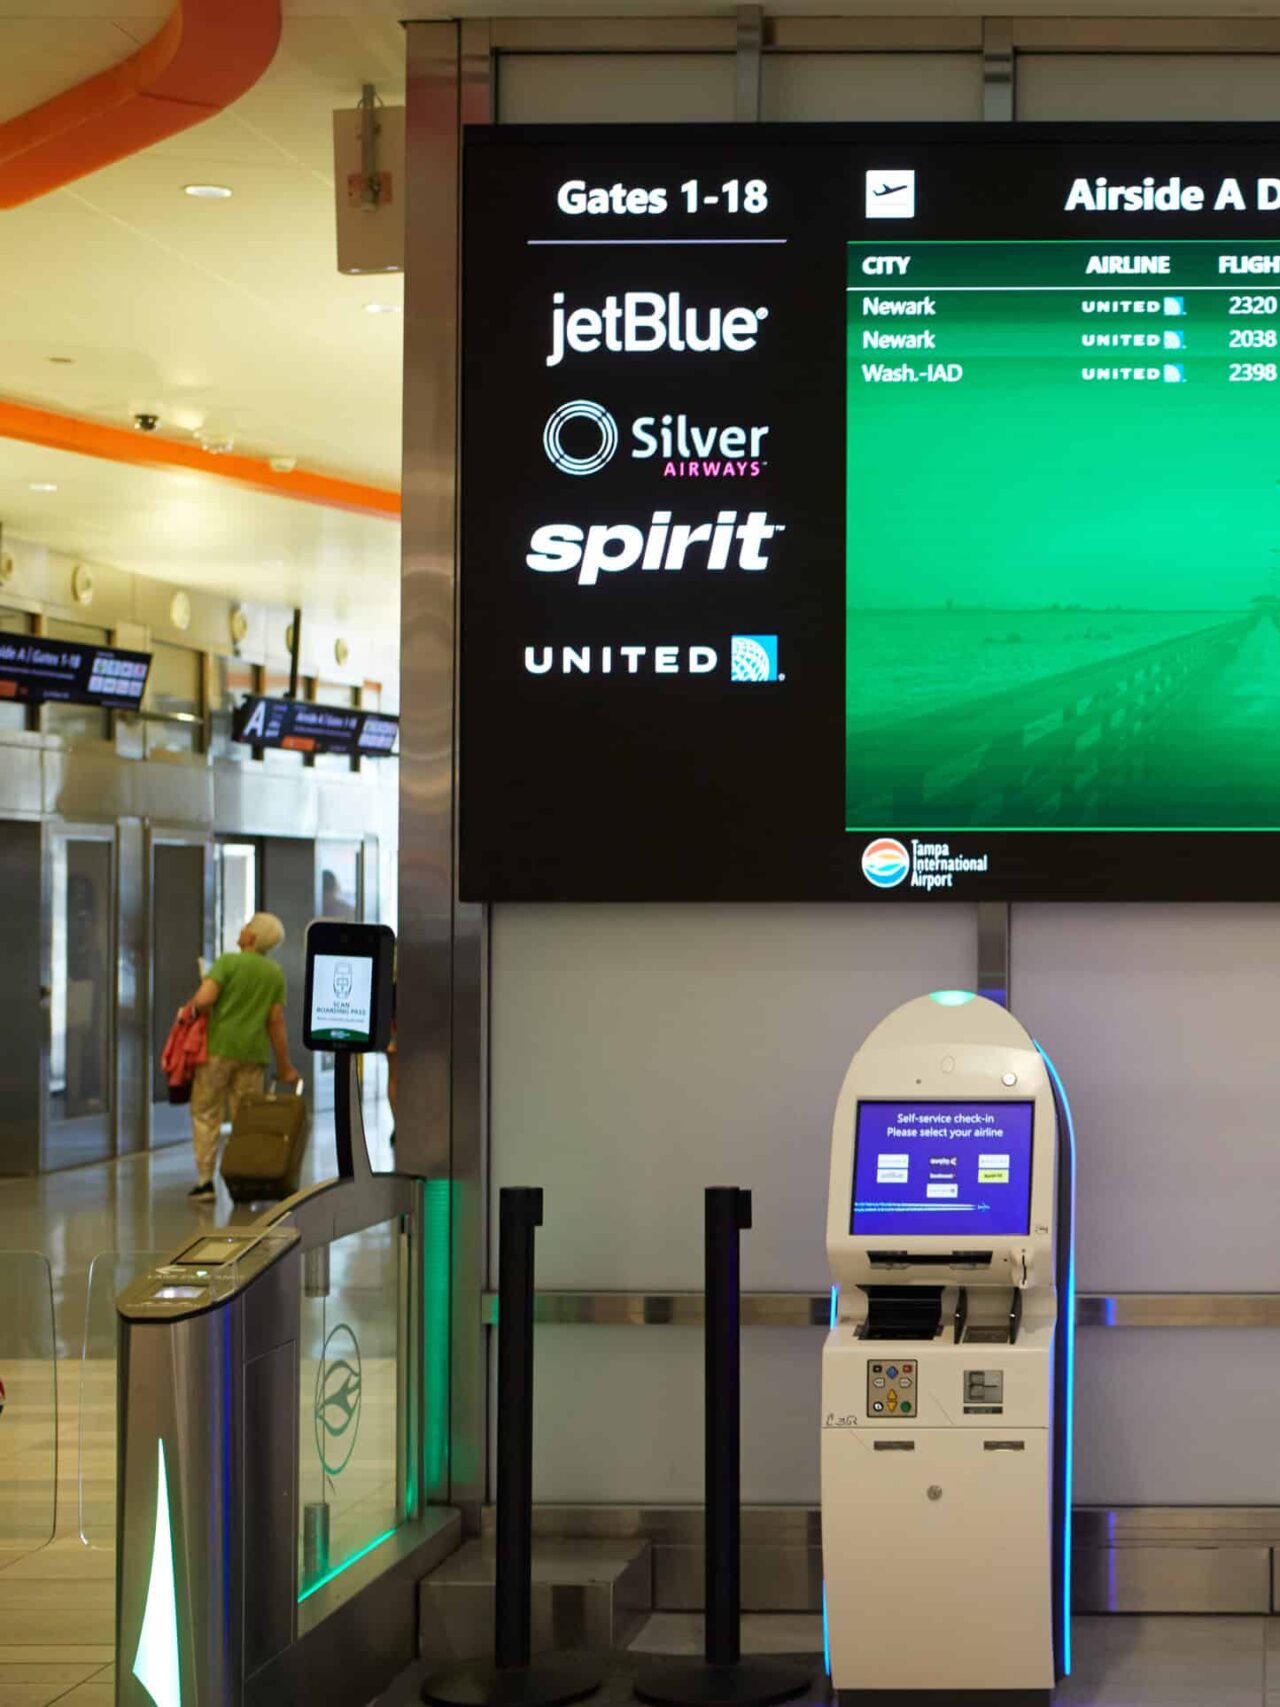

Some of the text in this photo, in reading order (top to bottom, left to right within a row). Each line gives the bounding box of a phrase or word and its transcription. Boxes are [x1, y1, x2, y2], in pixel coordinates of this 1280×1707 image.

[557, 179, 768, 214] Gates 1-18
[1064, 177, 1204, 211] Airside
[1213, 178, 1246, 210] A
[862, 255, 911, 275] CITY
[1085, 255, 1171, 274] AIRLINE
[862, 296, 936, 316] Newark
[1081, 300, 1160, 313] UNITED
[1228, 296, 1277, 315] 2320
[546, 292, 762, 367] jetBlue
[862, 330, 936, 350] Newark
[1081, 334, 1160, 347] UNITED
[1228, 329, 1277, 348] 2038
[862, 363, 963, 383] Wash.-IAD
[1081, 367, 1160, 380] UNITED
[1228, 363, 1277, 382] 2398
[631, 414, 770, 459] Silver
[664, 461, 761, 477] AIRWAYS
[525, 511, 774, 586] spirit
[524, 646, 718, 674] UNITED
[243, 700, 266, 738] A
[911, 839, 949, 859] Tampa
[912, 854, 988, 871] International
[910, 870, 953, 891] Airport
[897, 1113, 995, 1124] Self-service check-in
[887, 1127, 1004, 1139] Please select your airline
